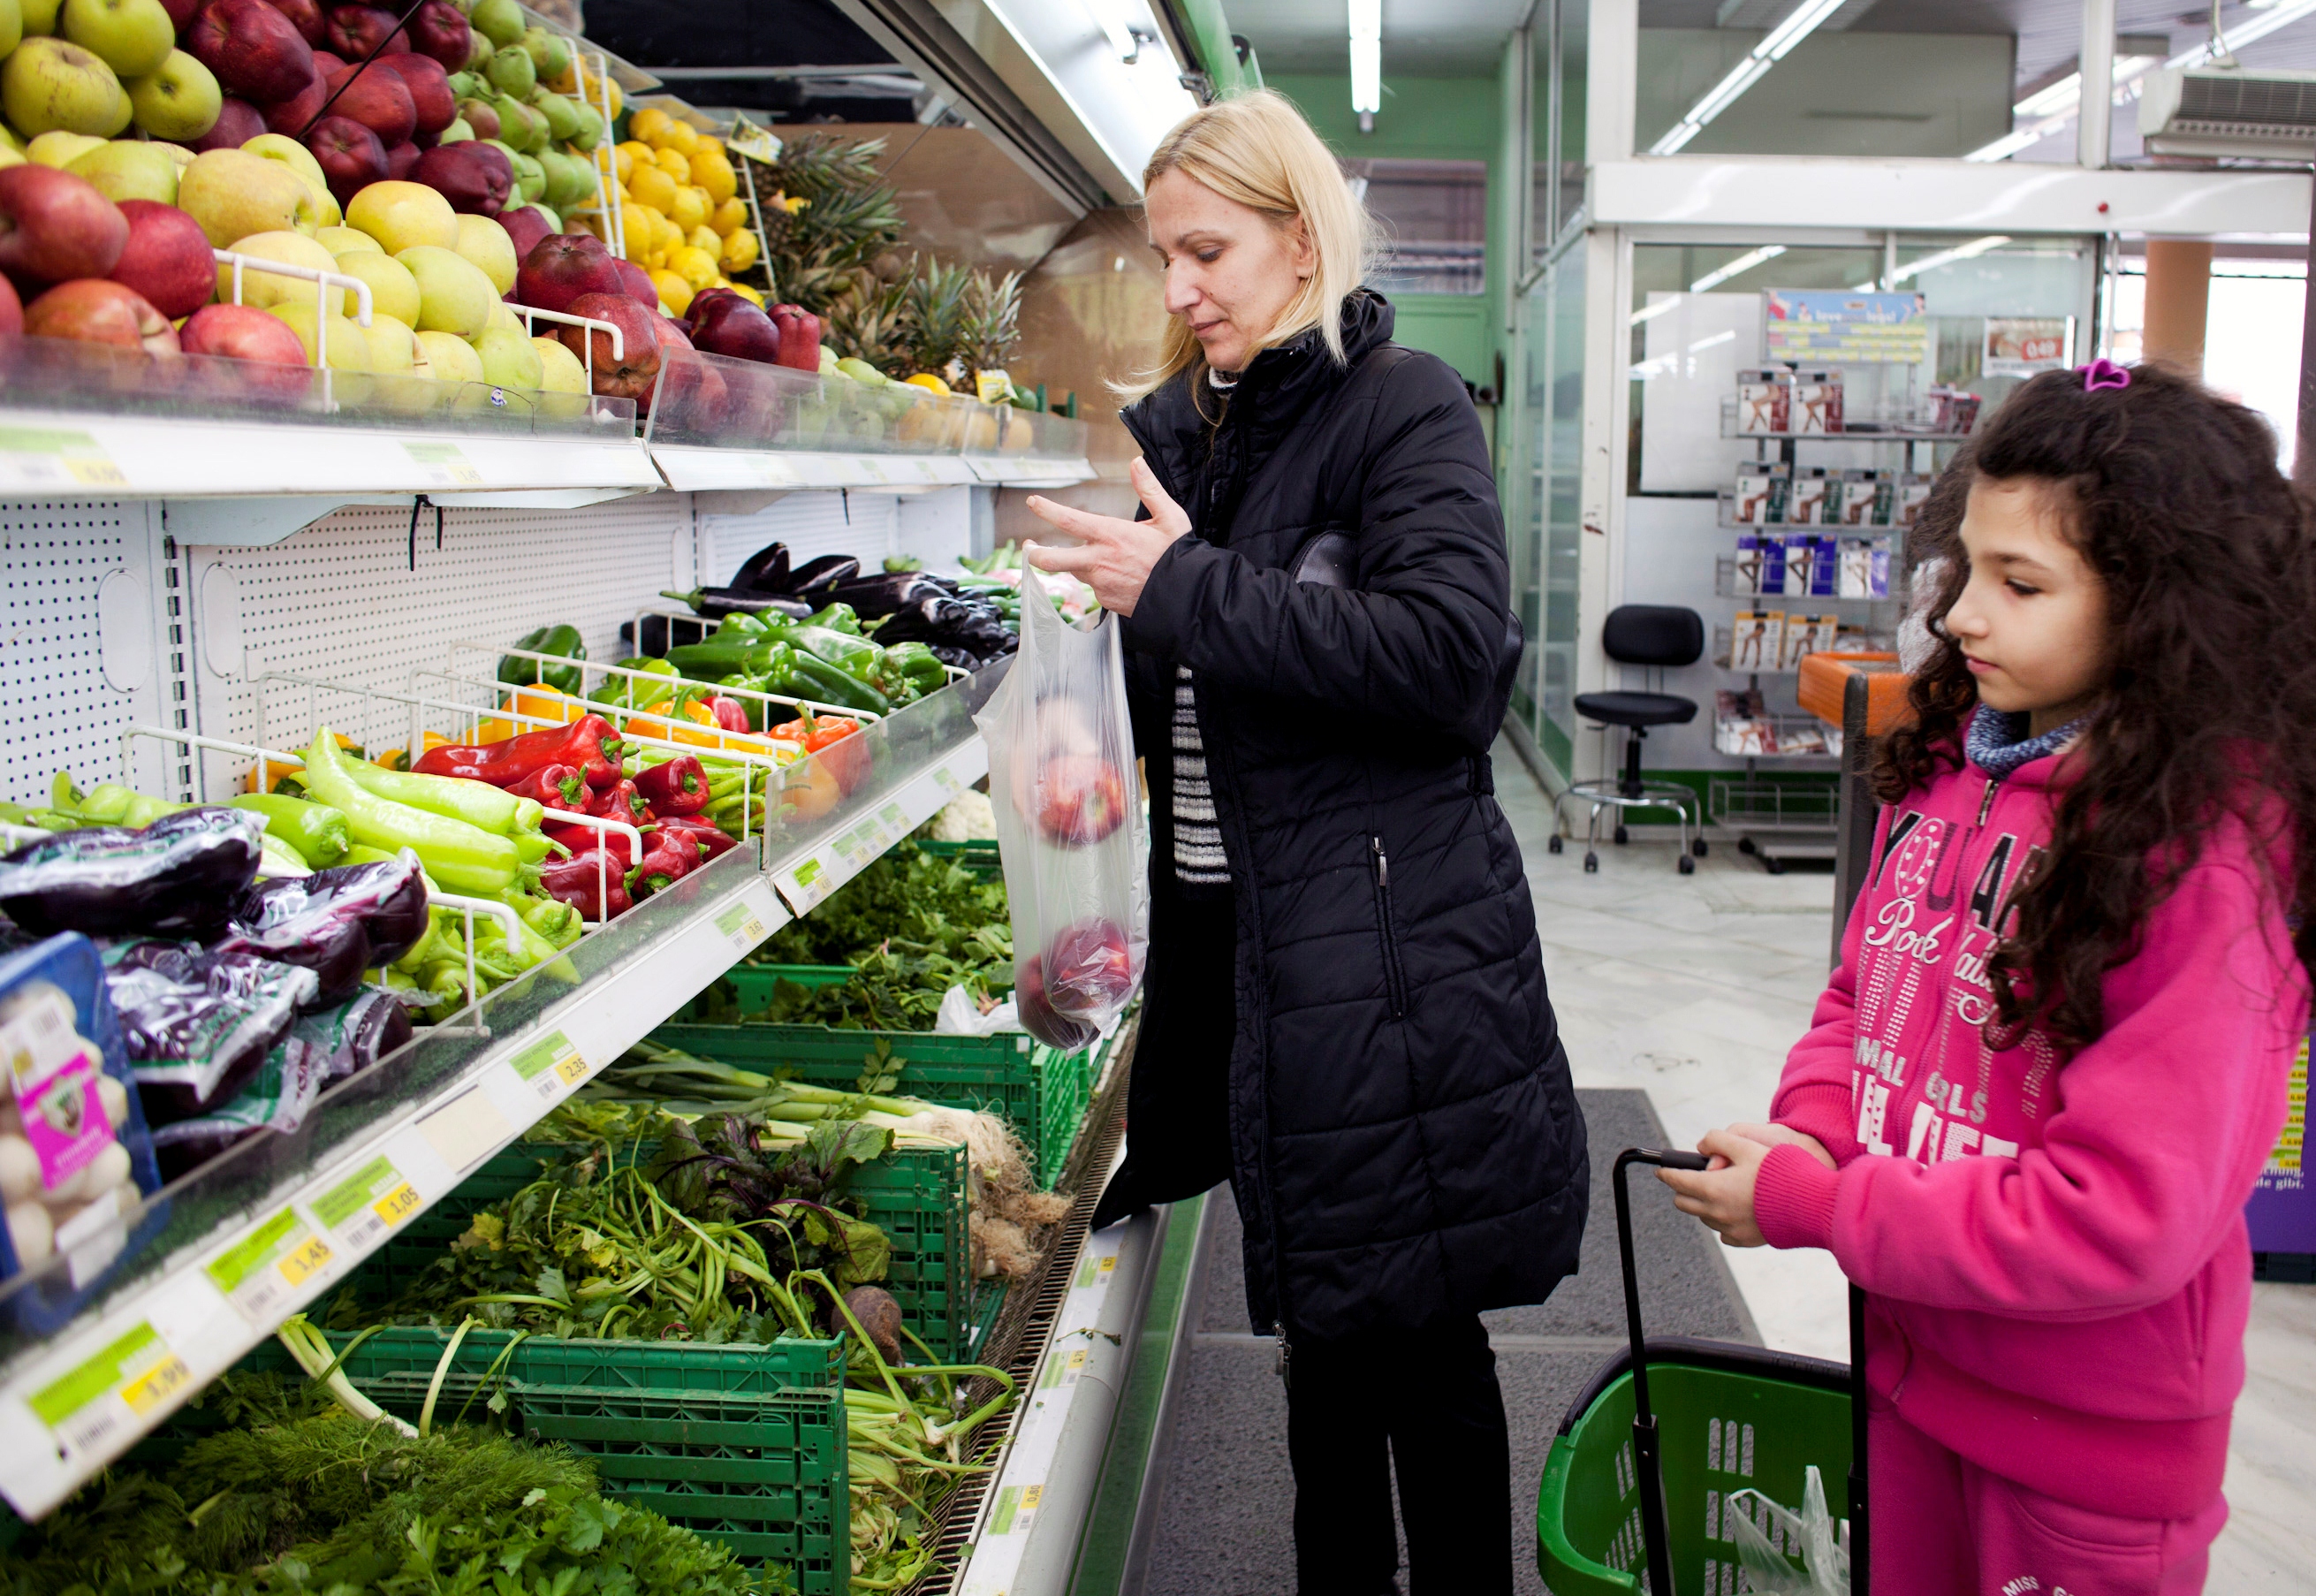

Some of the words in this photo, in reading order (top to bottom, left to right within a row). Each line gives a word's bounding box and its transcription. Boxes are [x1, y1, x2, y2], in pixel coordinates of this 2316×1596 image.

[749, 919, 764, 938] 3,62
[566, 1058, 587, 1077] 2,35
[390, 1187, 421, 1217] 1,05
[294, 1242, 330, 1274] 1,45
[1027, 1485, 1041, 1502] 0,80
[2001, 1576, 2040, 1596] MISS
